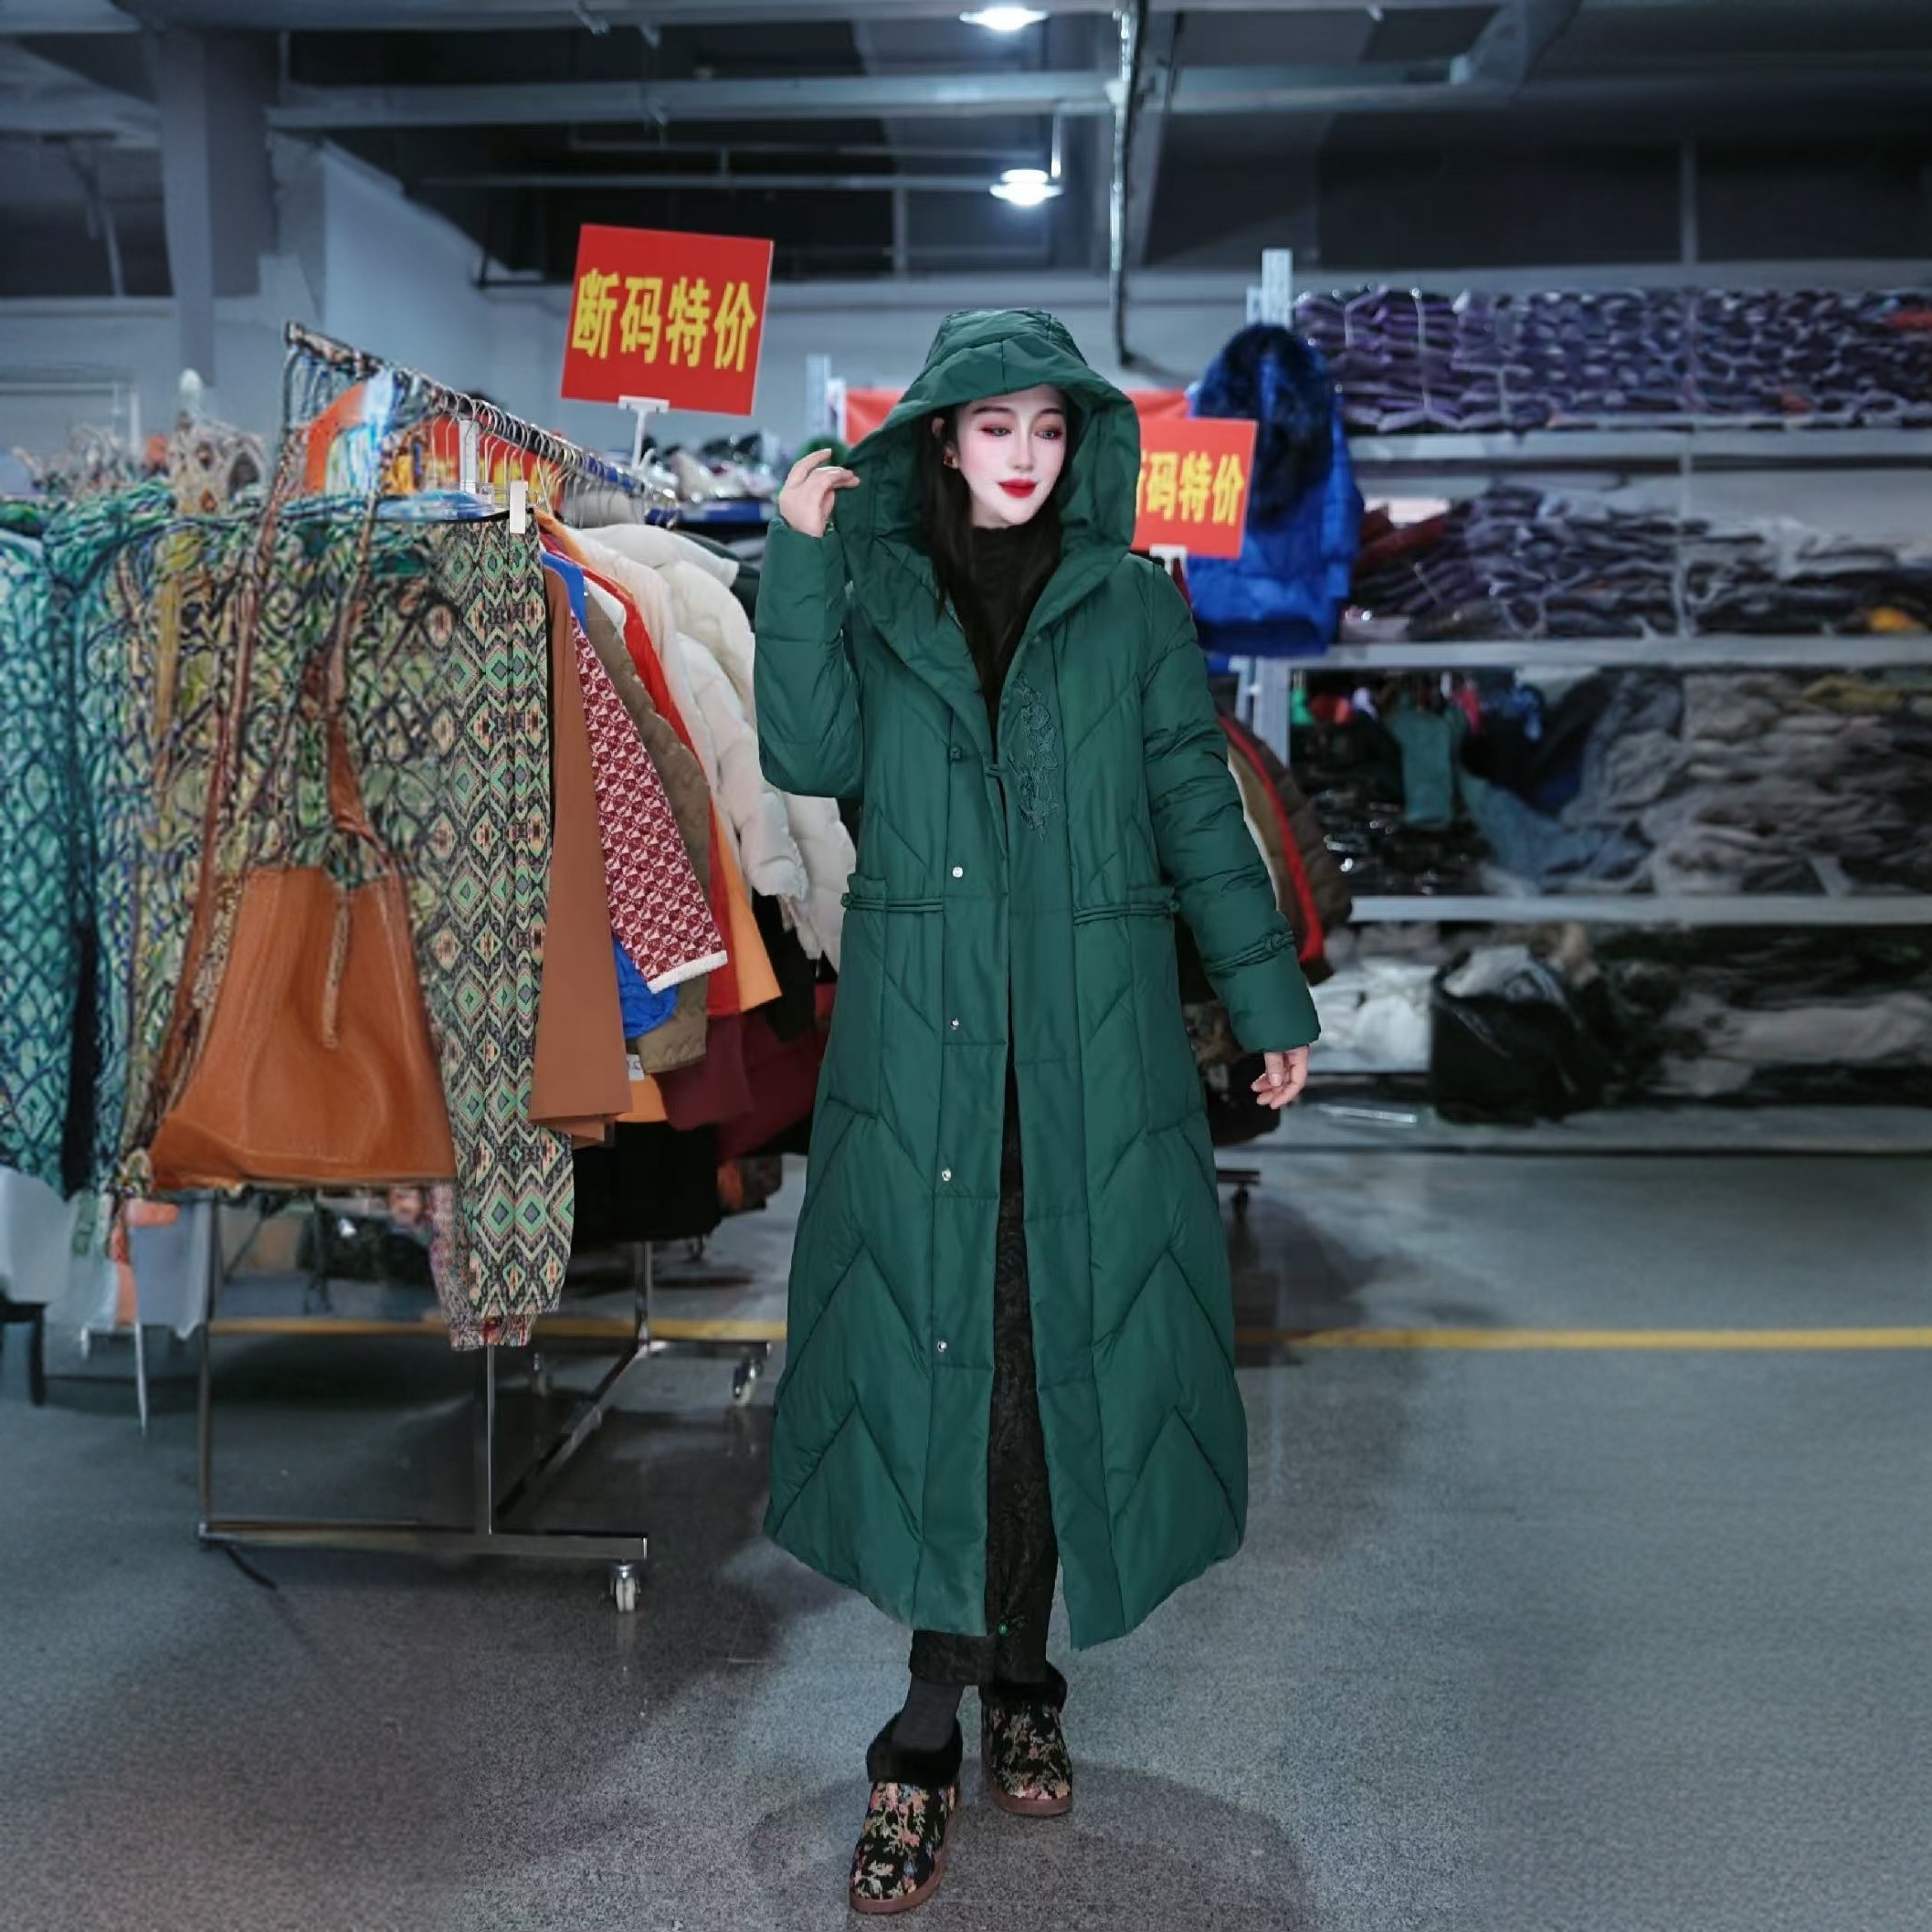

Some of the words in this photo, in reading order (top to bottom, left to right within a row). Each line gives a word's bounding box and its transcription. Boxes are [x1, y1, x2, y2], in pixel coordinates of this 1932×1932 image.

[572, 269, 756, 372] 断码特价
[1136, 449, 1244, 526] 码特价
